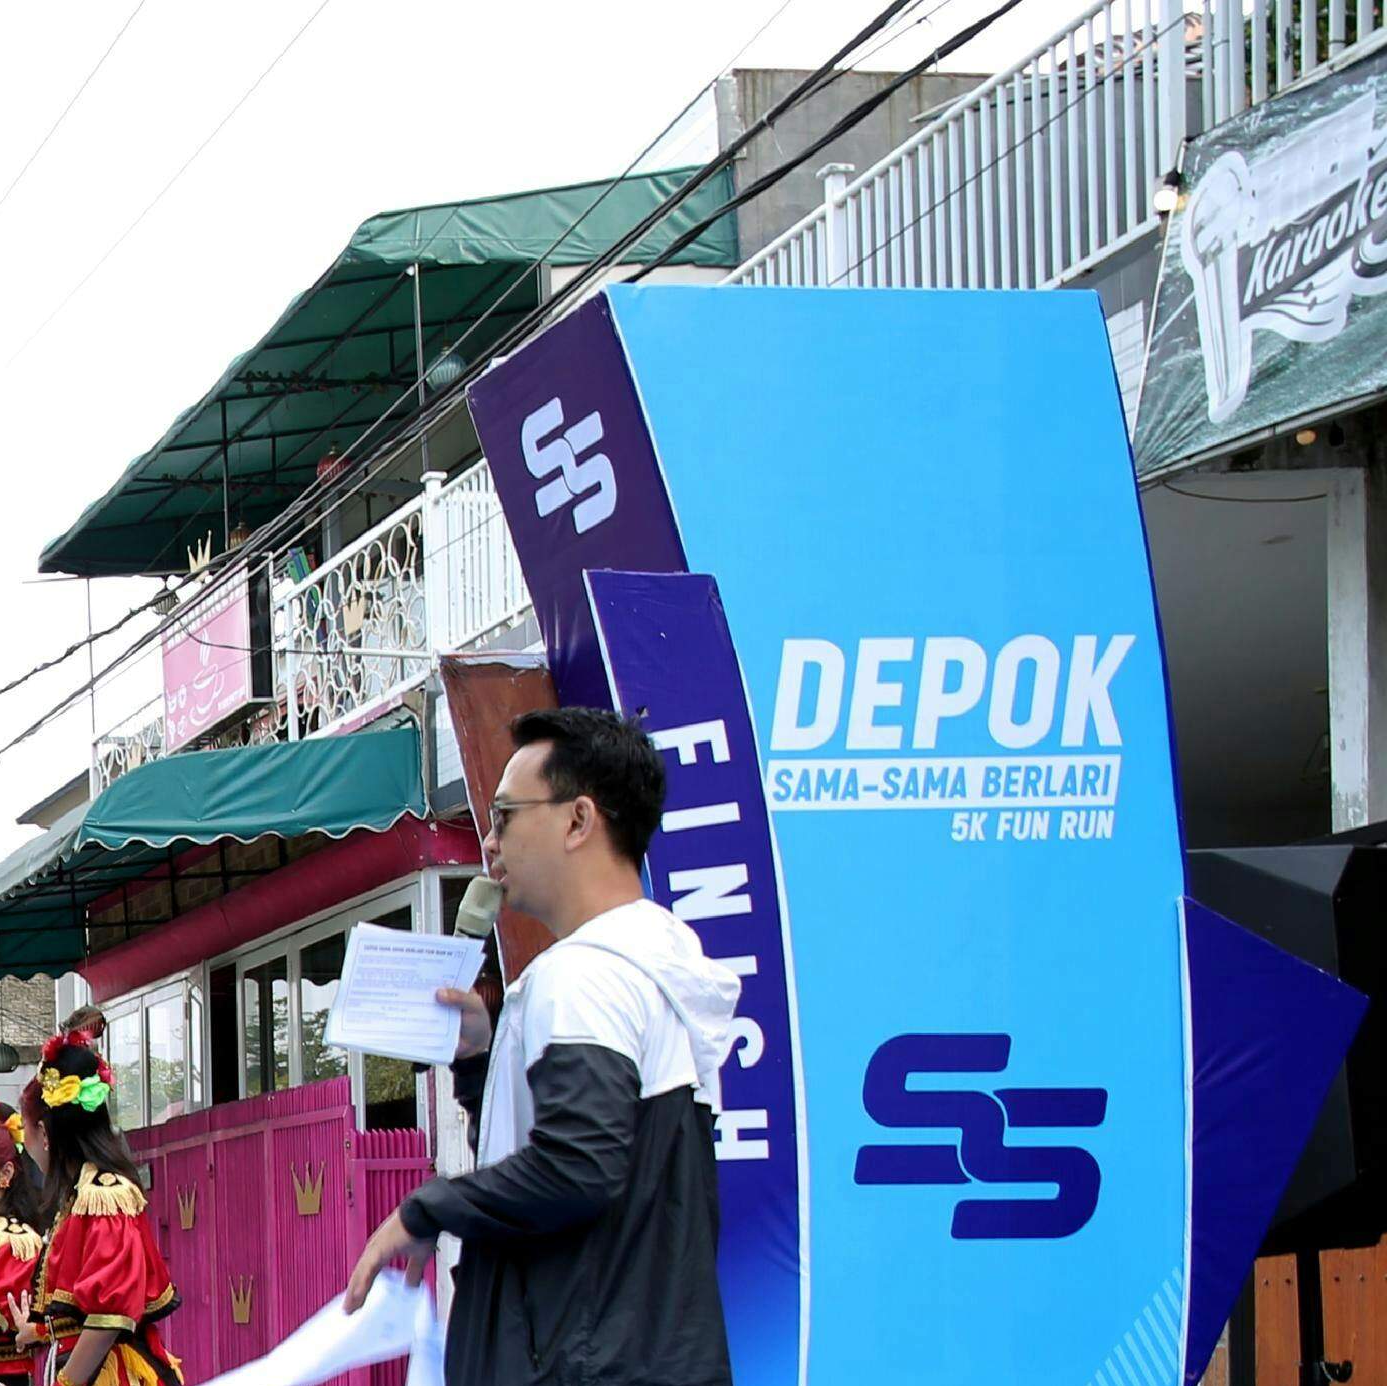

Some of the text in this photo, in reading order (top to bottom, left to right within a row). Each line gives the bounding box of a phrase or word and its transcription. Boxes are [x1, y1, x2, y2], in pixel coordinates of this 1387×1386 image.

[1243, 168, 1387, 306] Karaoke
[770, 634, 1136, 752] DEPOK
[772, 761, 1112, 803] SAMA-SAMA BERLARI
[950, 810, 1115, 842] 5K FUN RUN
